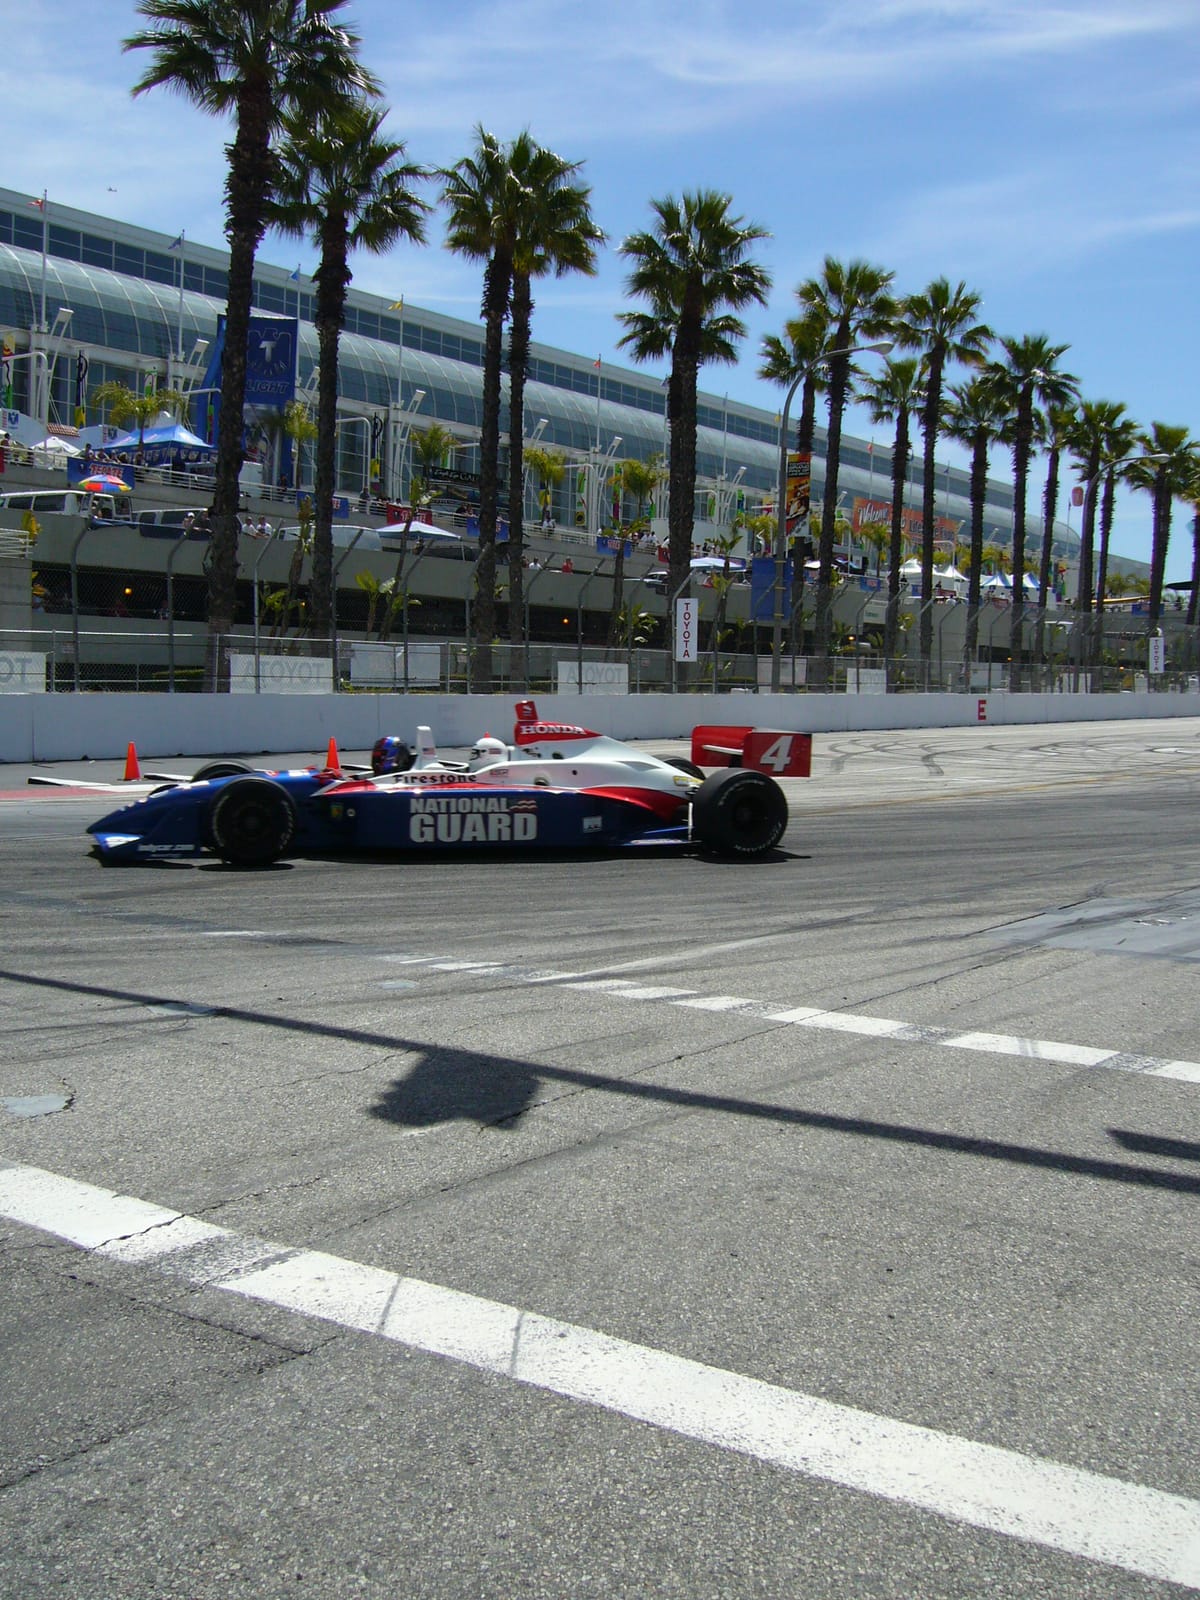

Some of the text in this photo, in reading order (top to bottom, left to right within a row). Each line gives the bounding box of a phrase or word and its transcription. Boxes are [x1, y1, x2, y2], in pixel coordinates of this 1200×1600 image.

[683, 603, 691, 657] TOYOTA
[978, 699, 986, 720] E
[520, 725, 586, 734] HONDA
[760, 735, 793, 772] 4
[393, 774, 477, 783] Firestone
[410, 797, 509, 813] NATIONAL
[410, 813, 537, 842] GUARD
